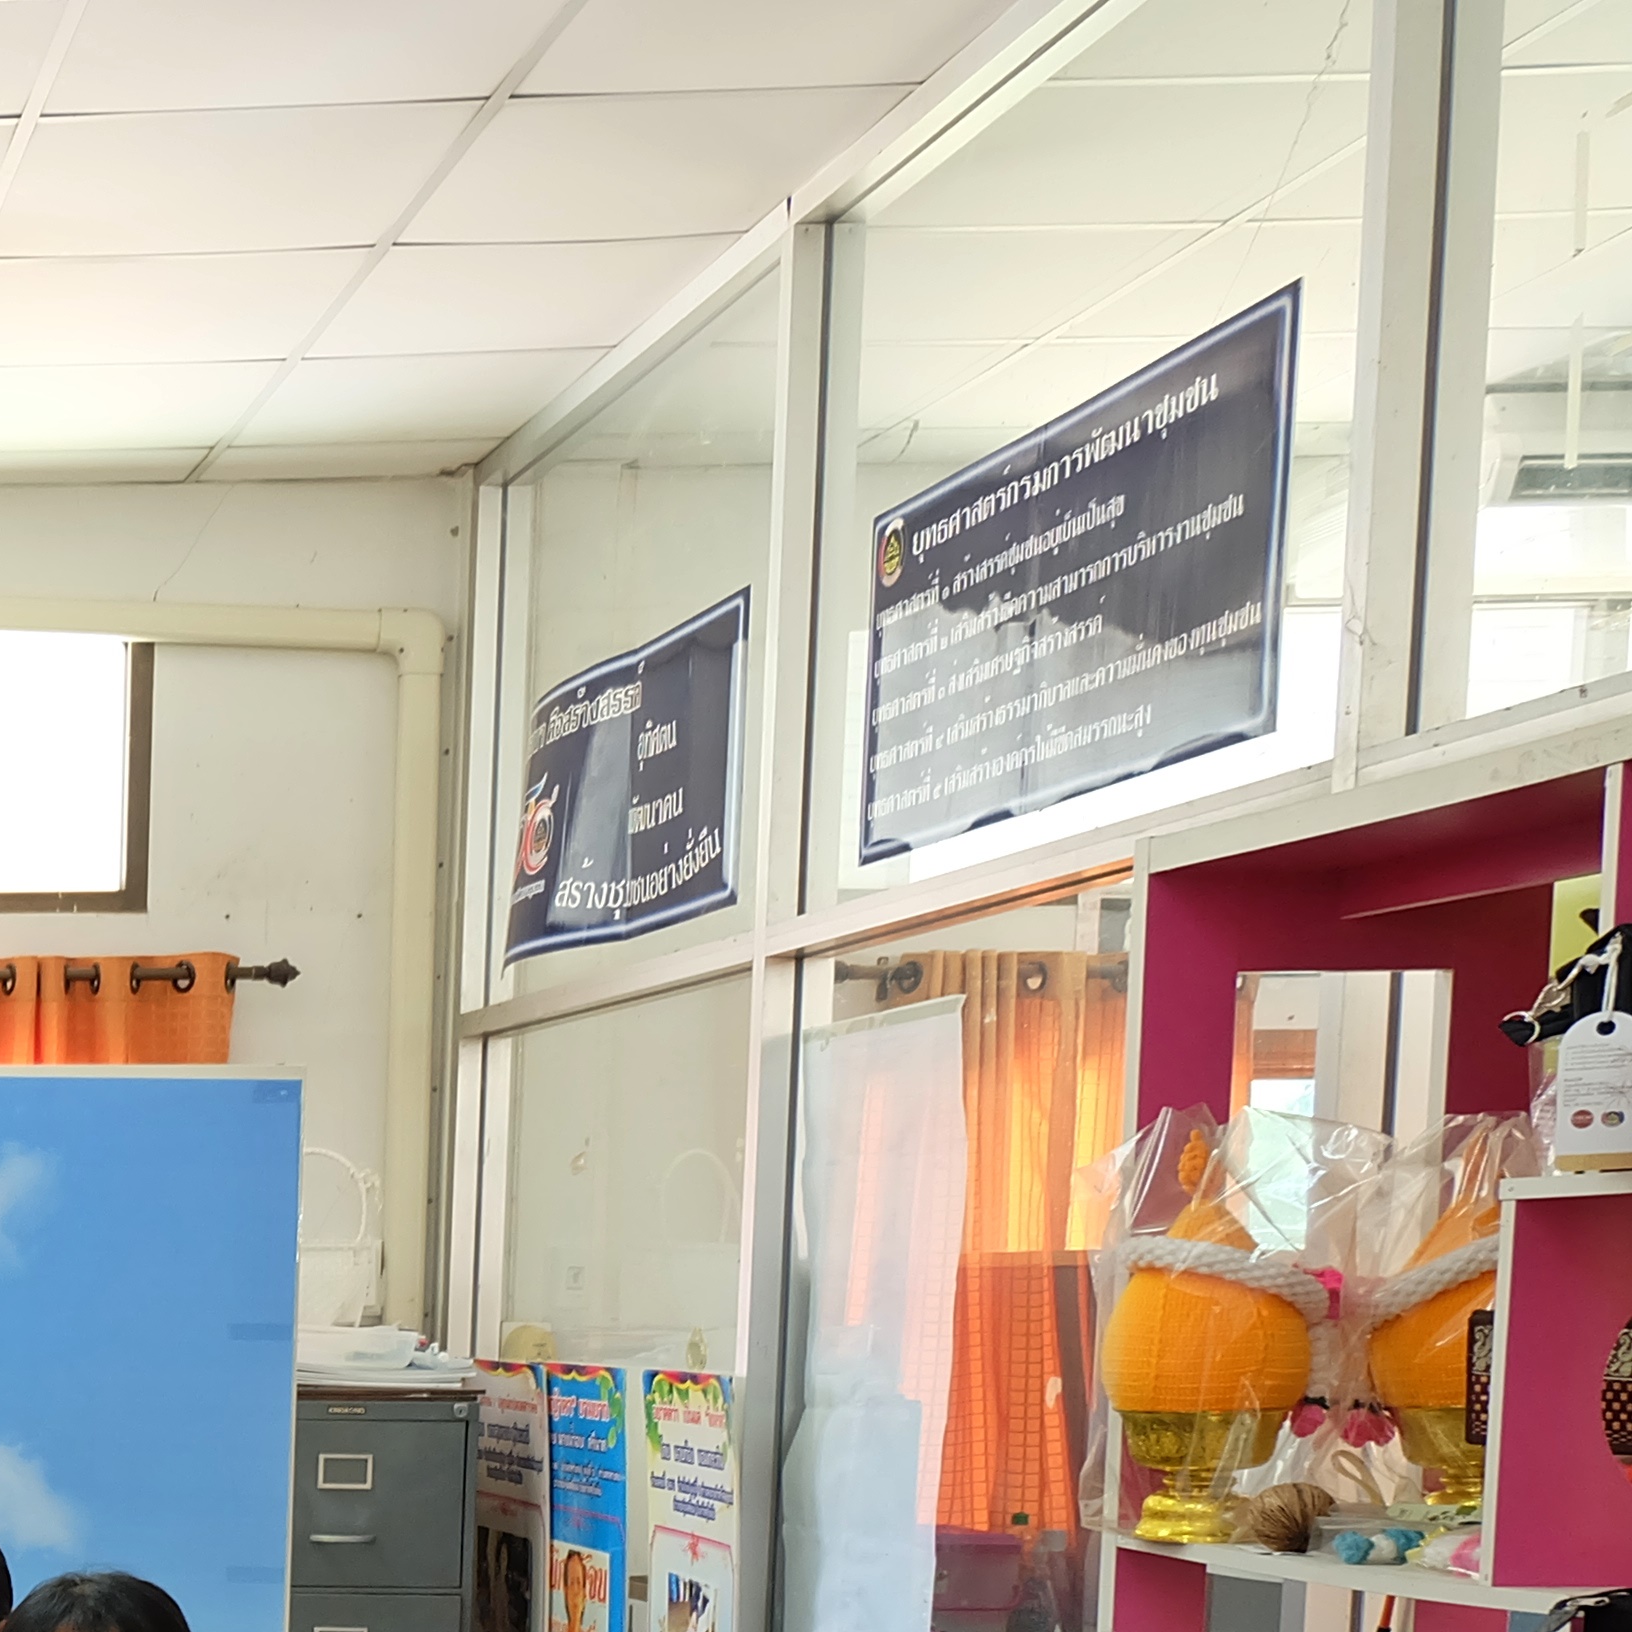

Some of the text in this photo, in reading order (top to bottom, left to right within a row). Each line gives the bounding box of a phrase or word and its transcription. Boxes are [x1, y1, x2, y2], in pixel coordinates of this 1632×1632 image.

[912, 373, 1220, 564] ยุทธศาสตร์กรมการพัฒนาชุมชน
[876, 569, 941, 637] ยุทธศาสตร์ที่
[874, 618, 939, 686] ยุทธศาสตร์ที่
[545, 661, 645, 745] คือสร้างสรรค์
[871, 668, 936, 733] ยุทธศาสตร์ที่
[636, 719, 677, 771] อุทิศตน
[869, 720, 934, 779] ยุทธศาสตร์ที่
[628, 785, 684, 836] พัฒนาคน
[867, 768, 931, 828] ยุทธศาสตร์ที่
[554, 828, 722, 920] สร้างชุมชนอย่างยั่งยืน
